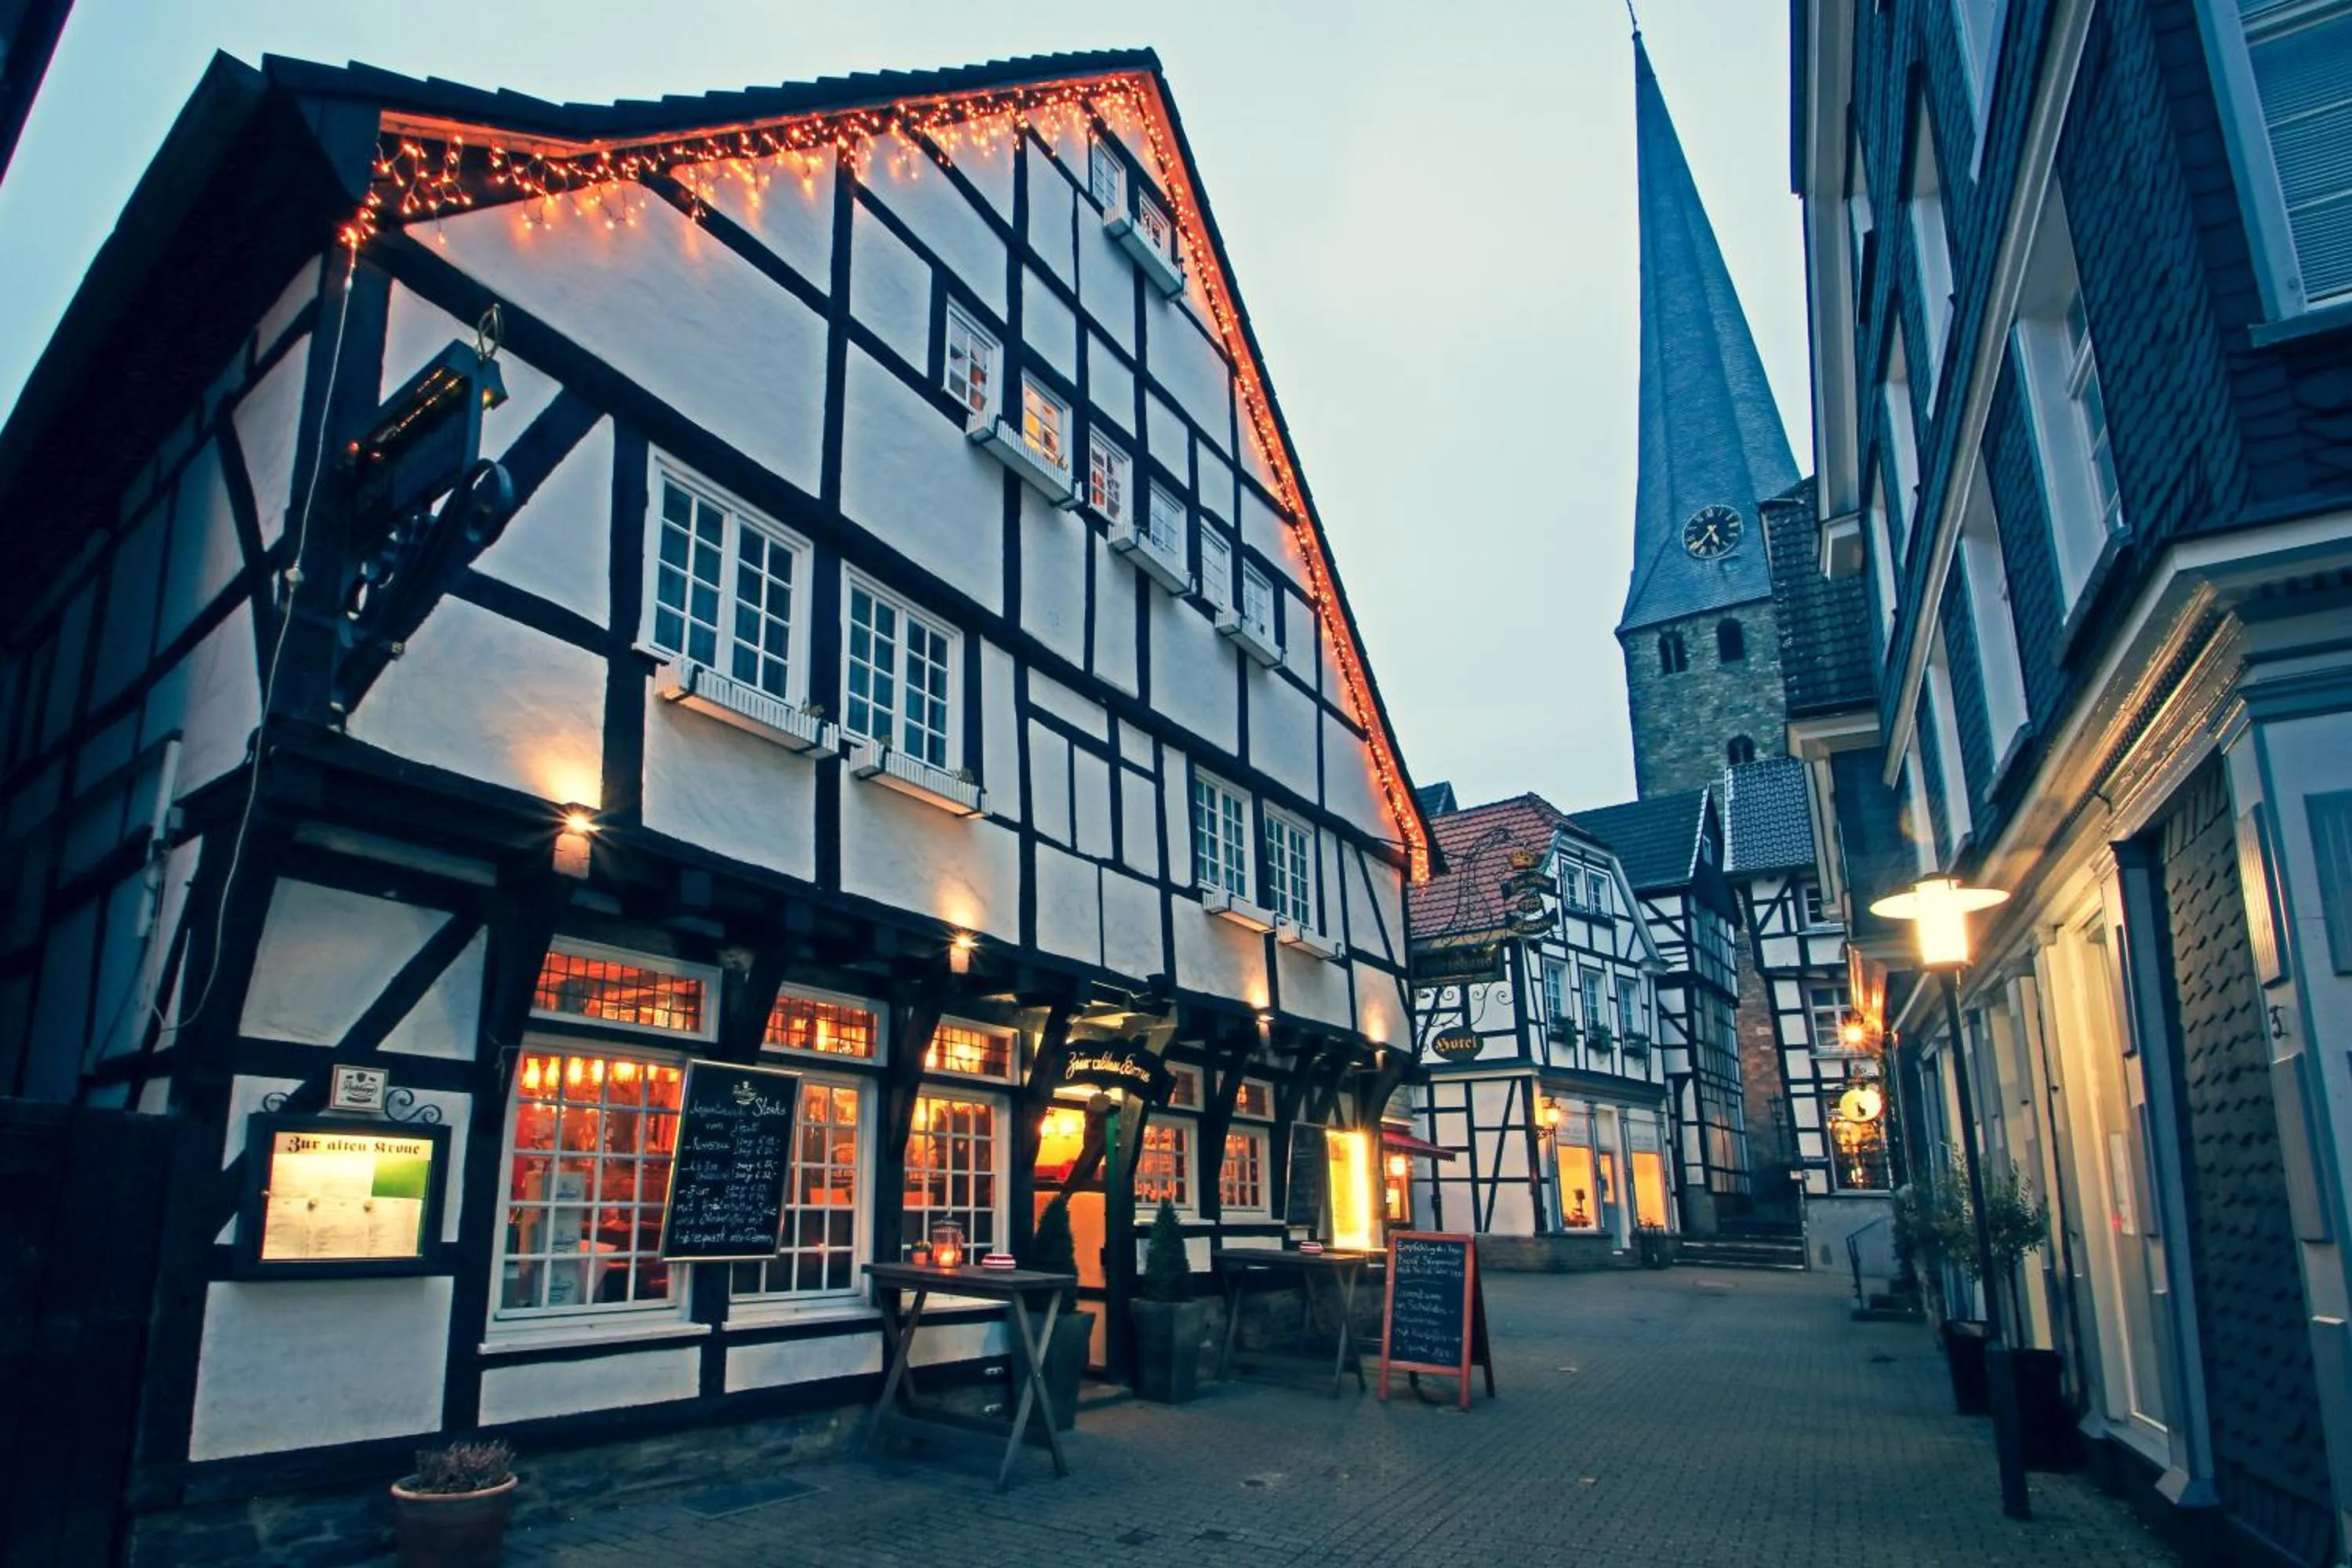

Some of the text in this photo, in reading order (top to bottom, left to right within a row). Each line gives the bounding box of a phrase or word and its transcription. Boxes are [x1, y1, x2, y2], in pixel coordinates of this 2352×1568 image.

[1436, 1035, 1477, 1052] Hotel
[288, 1135, 420, 1154] Zur alten Krone
